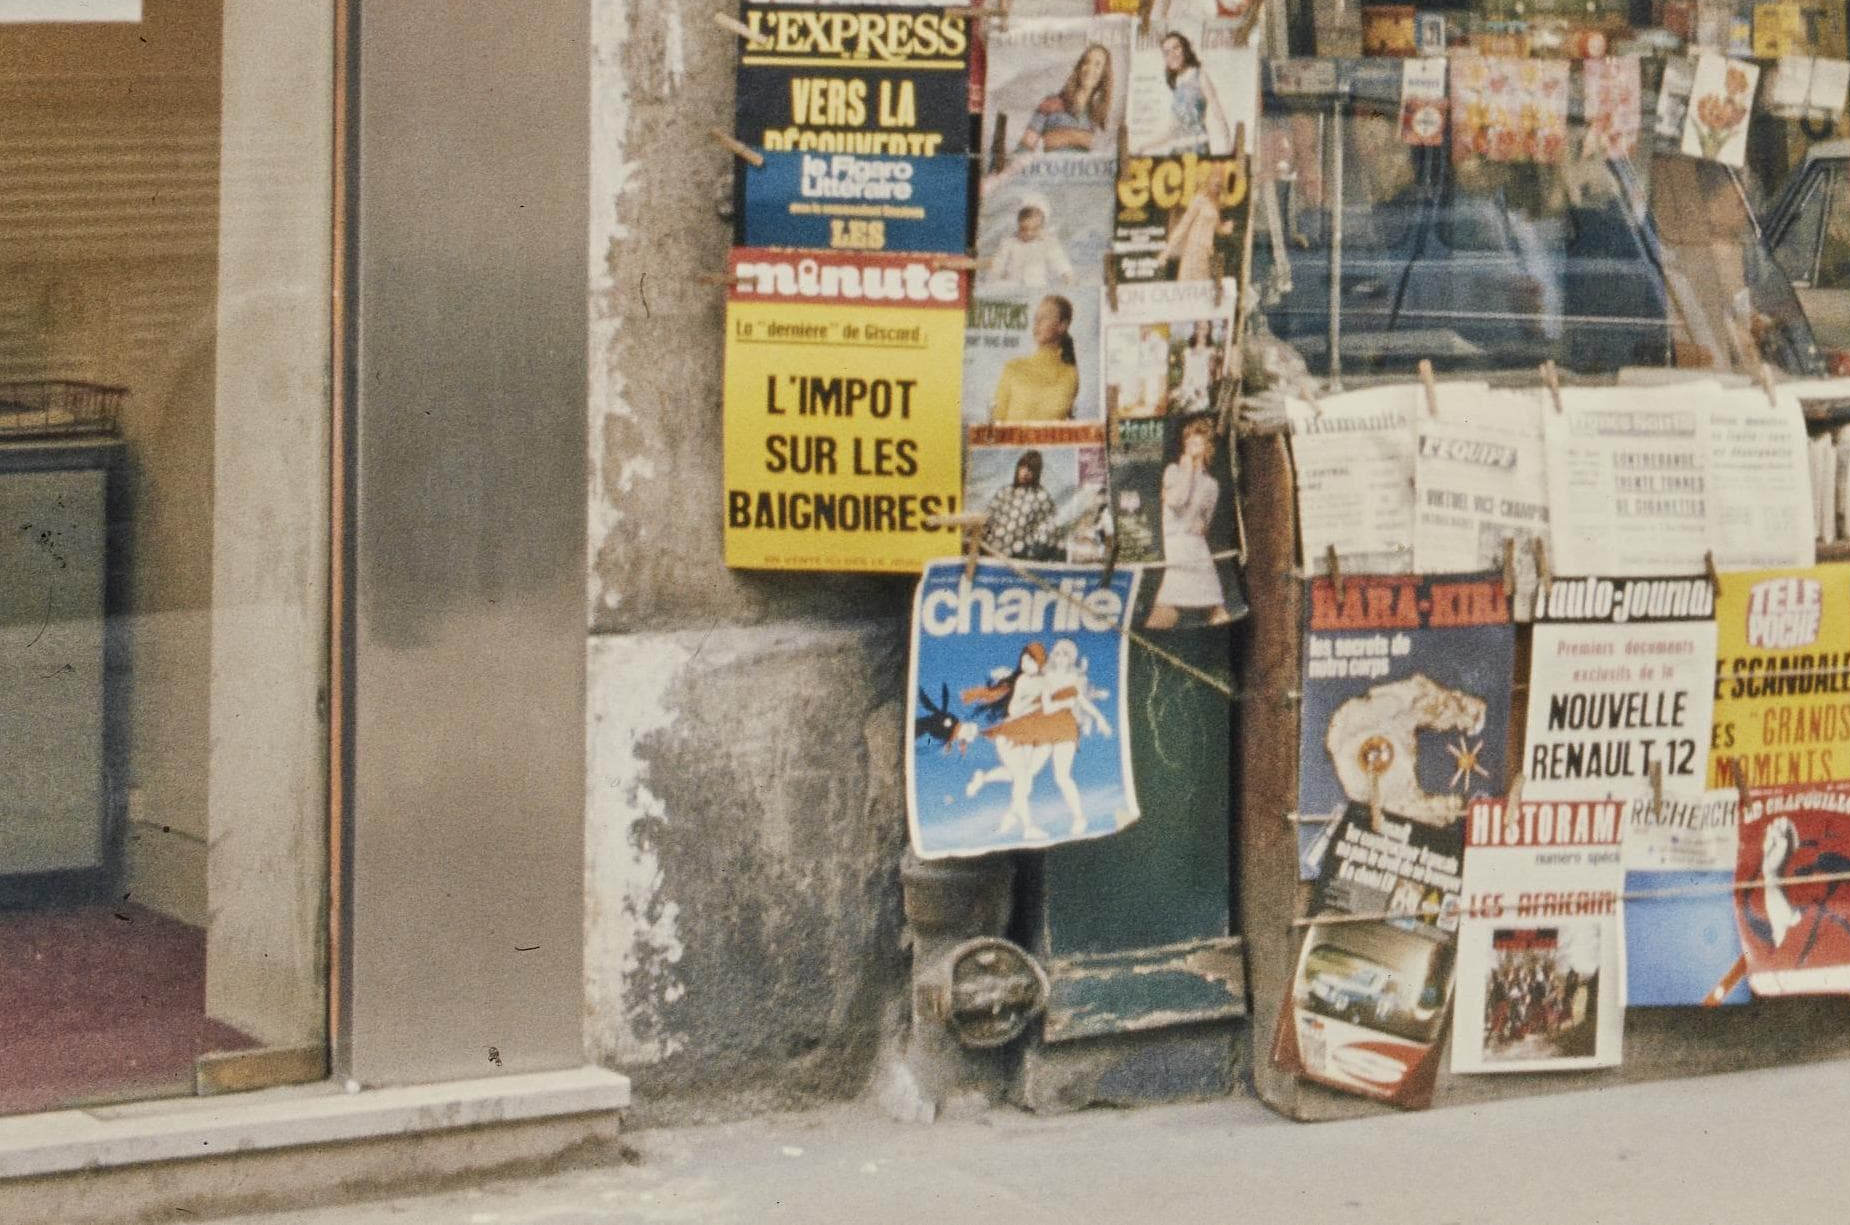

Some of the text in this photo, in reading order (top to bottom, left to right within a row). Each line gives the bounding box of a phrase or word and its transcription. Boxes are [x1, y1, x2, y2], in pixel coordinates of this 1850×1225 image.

[746, 10, 967, 60] L'EXPRESS
[791, 78, 916, 127] VERS LA
[830, 155, 914, 180] Figaro
[829, 220, 886, 250] LES
[736, 259, 960, 302] minute
[843, 322, 860, 340] de
[766, 374, 917, 419] L'IMPOT
[764, 435, 919, 478] SUR LES
[728, 489, 959, 533] BAIGNOIRES!
[922, 578, 1123, 638] charlie
[1535, 576, 1716, 623] lauto-journal
[1548, 690, 1689, 732] NOUVELLE
[1531, 738, 1697, 782] RENAULT 12
[1630, 797, 1738, 829] RECHERCH
[1468, 892, 1505, 918] LES
